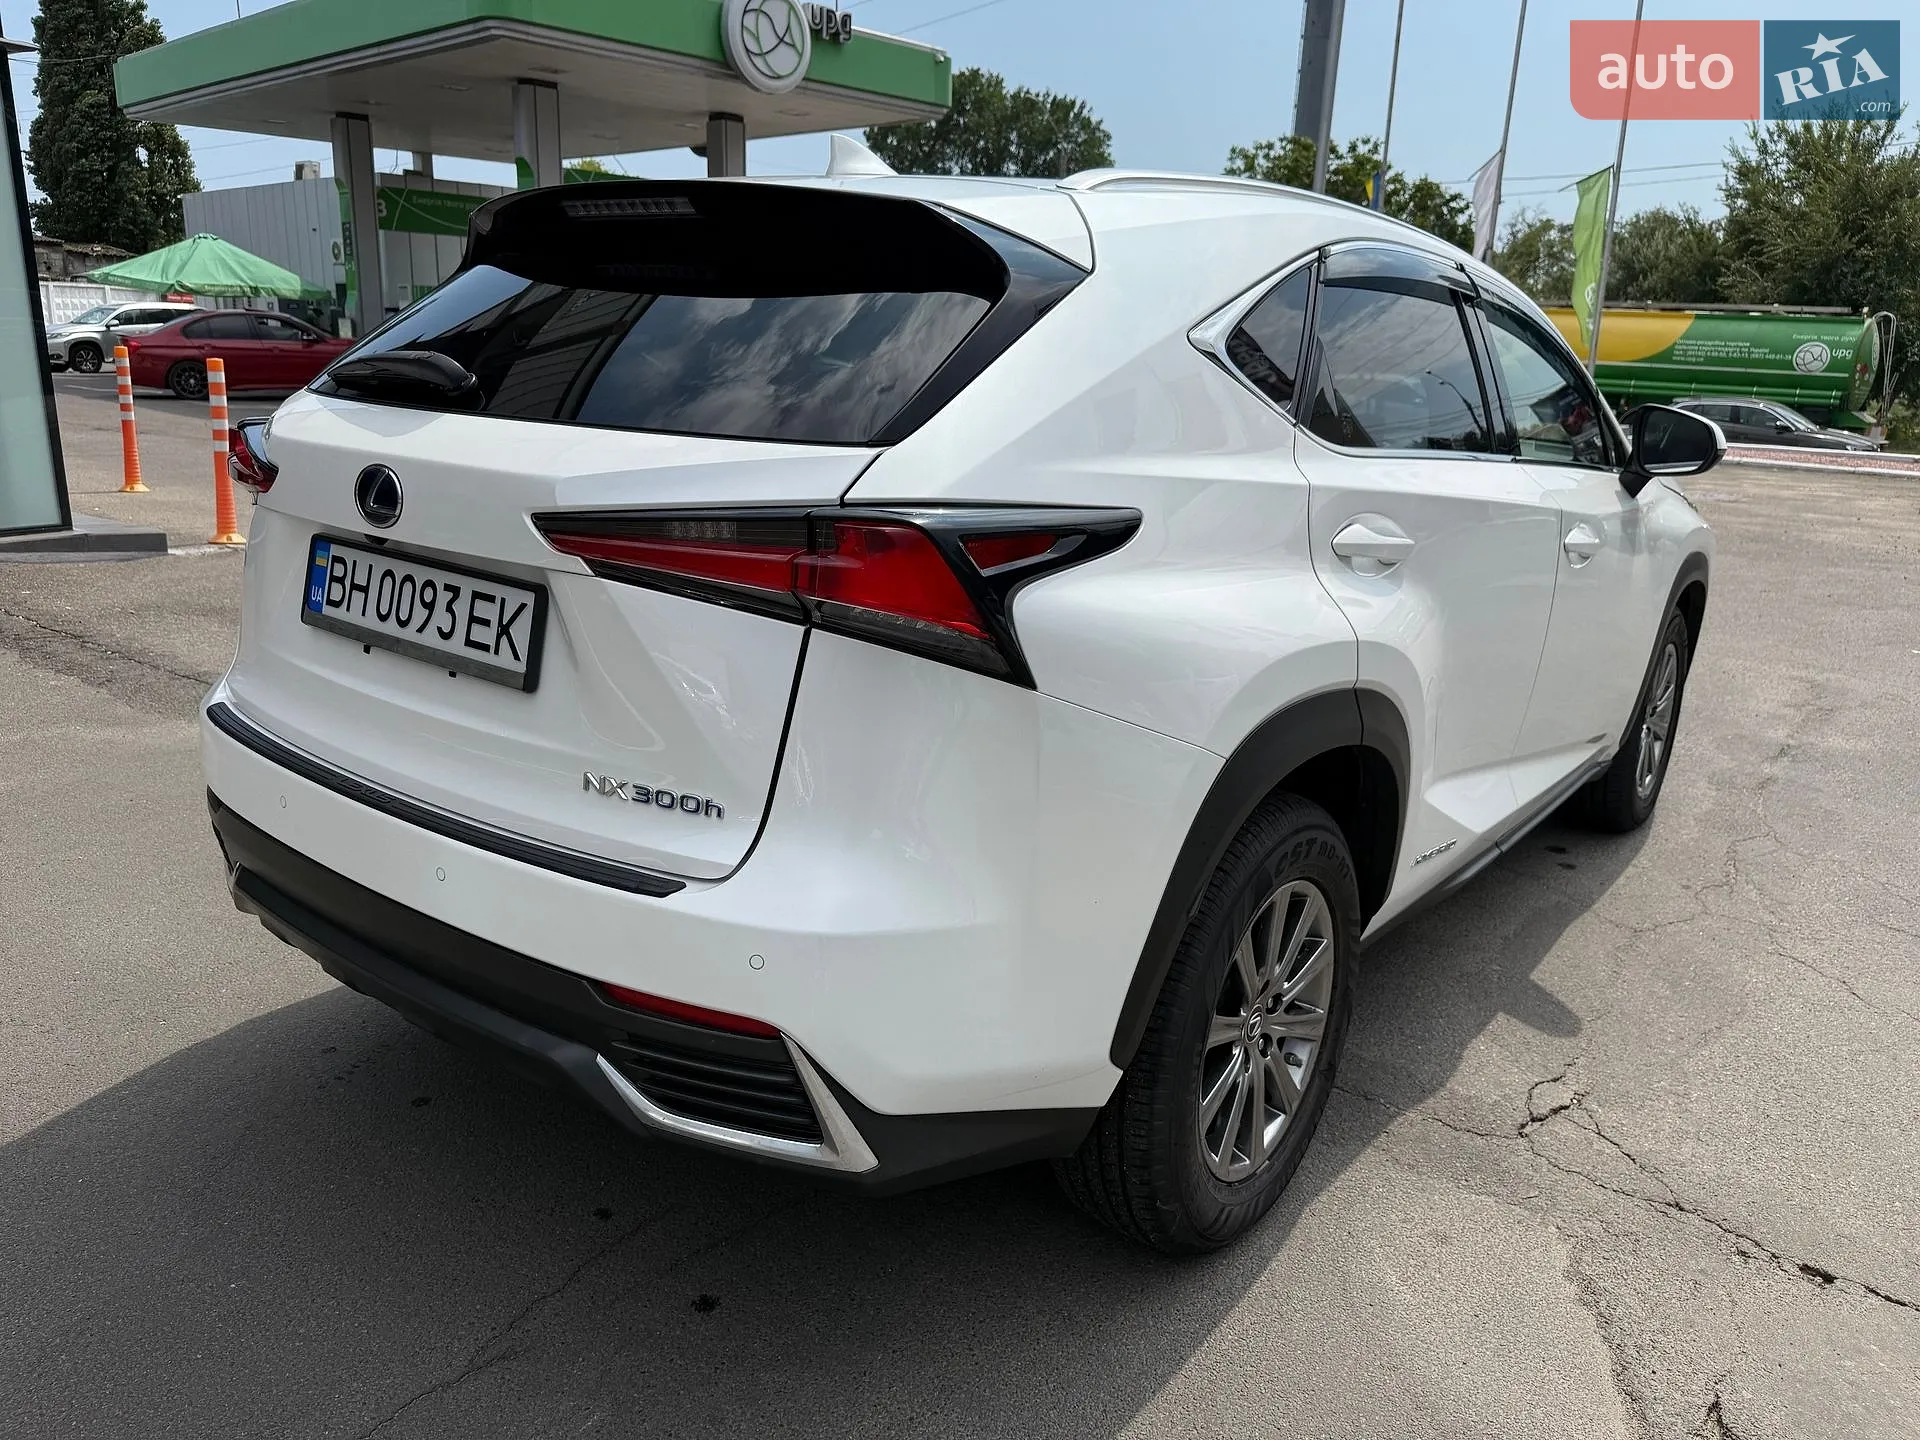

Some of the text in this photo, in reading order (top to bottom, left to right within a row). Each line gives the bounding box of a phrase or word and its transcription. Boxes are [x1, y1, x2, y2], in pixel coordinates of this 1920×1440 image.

[806, 4, 852, 43] upg
[1832, 348, 1854, 360] upg
[311, 584, 323, 604] UA
